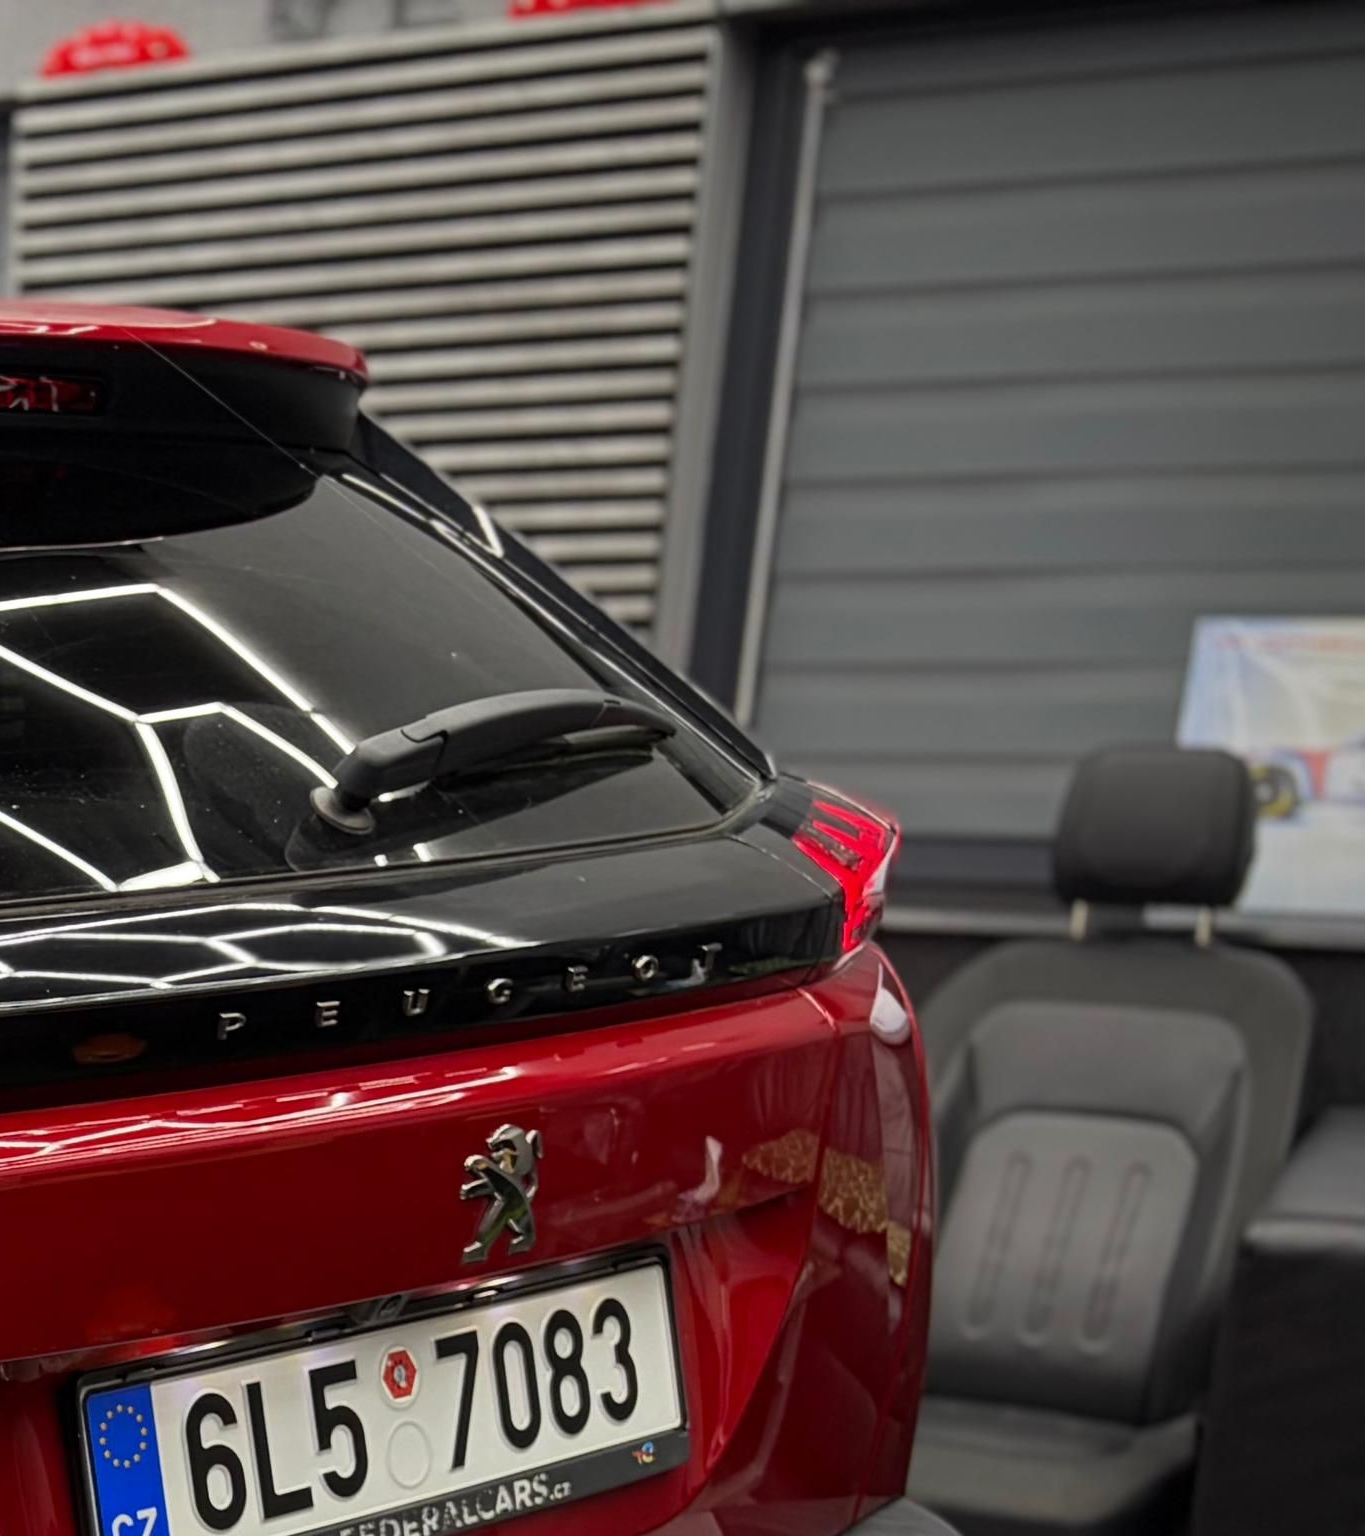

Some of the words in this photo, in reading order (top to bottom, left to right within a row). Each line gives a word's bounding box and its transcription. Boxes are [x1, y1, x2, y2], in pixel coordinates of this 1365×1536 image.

[218, 942, 724, 1040] PEUGEOT
[185, 1358, 369, 1532] 6L5
[433, 1297, 640, 1473] 7083
